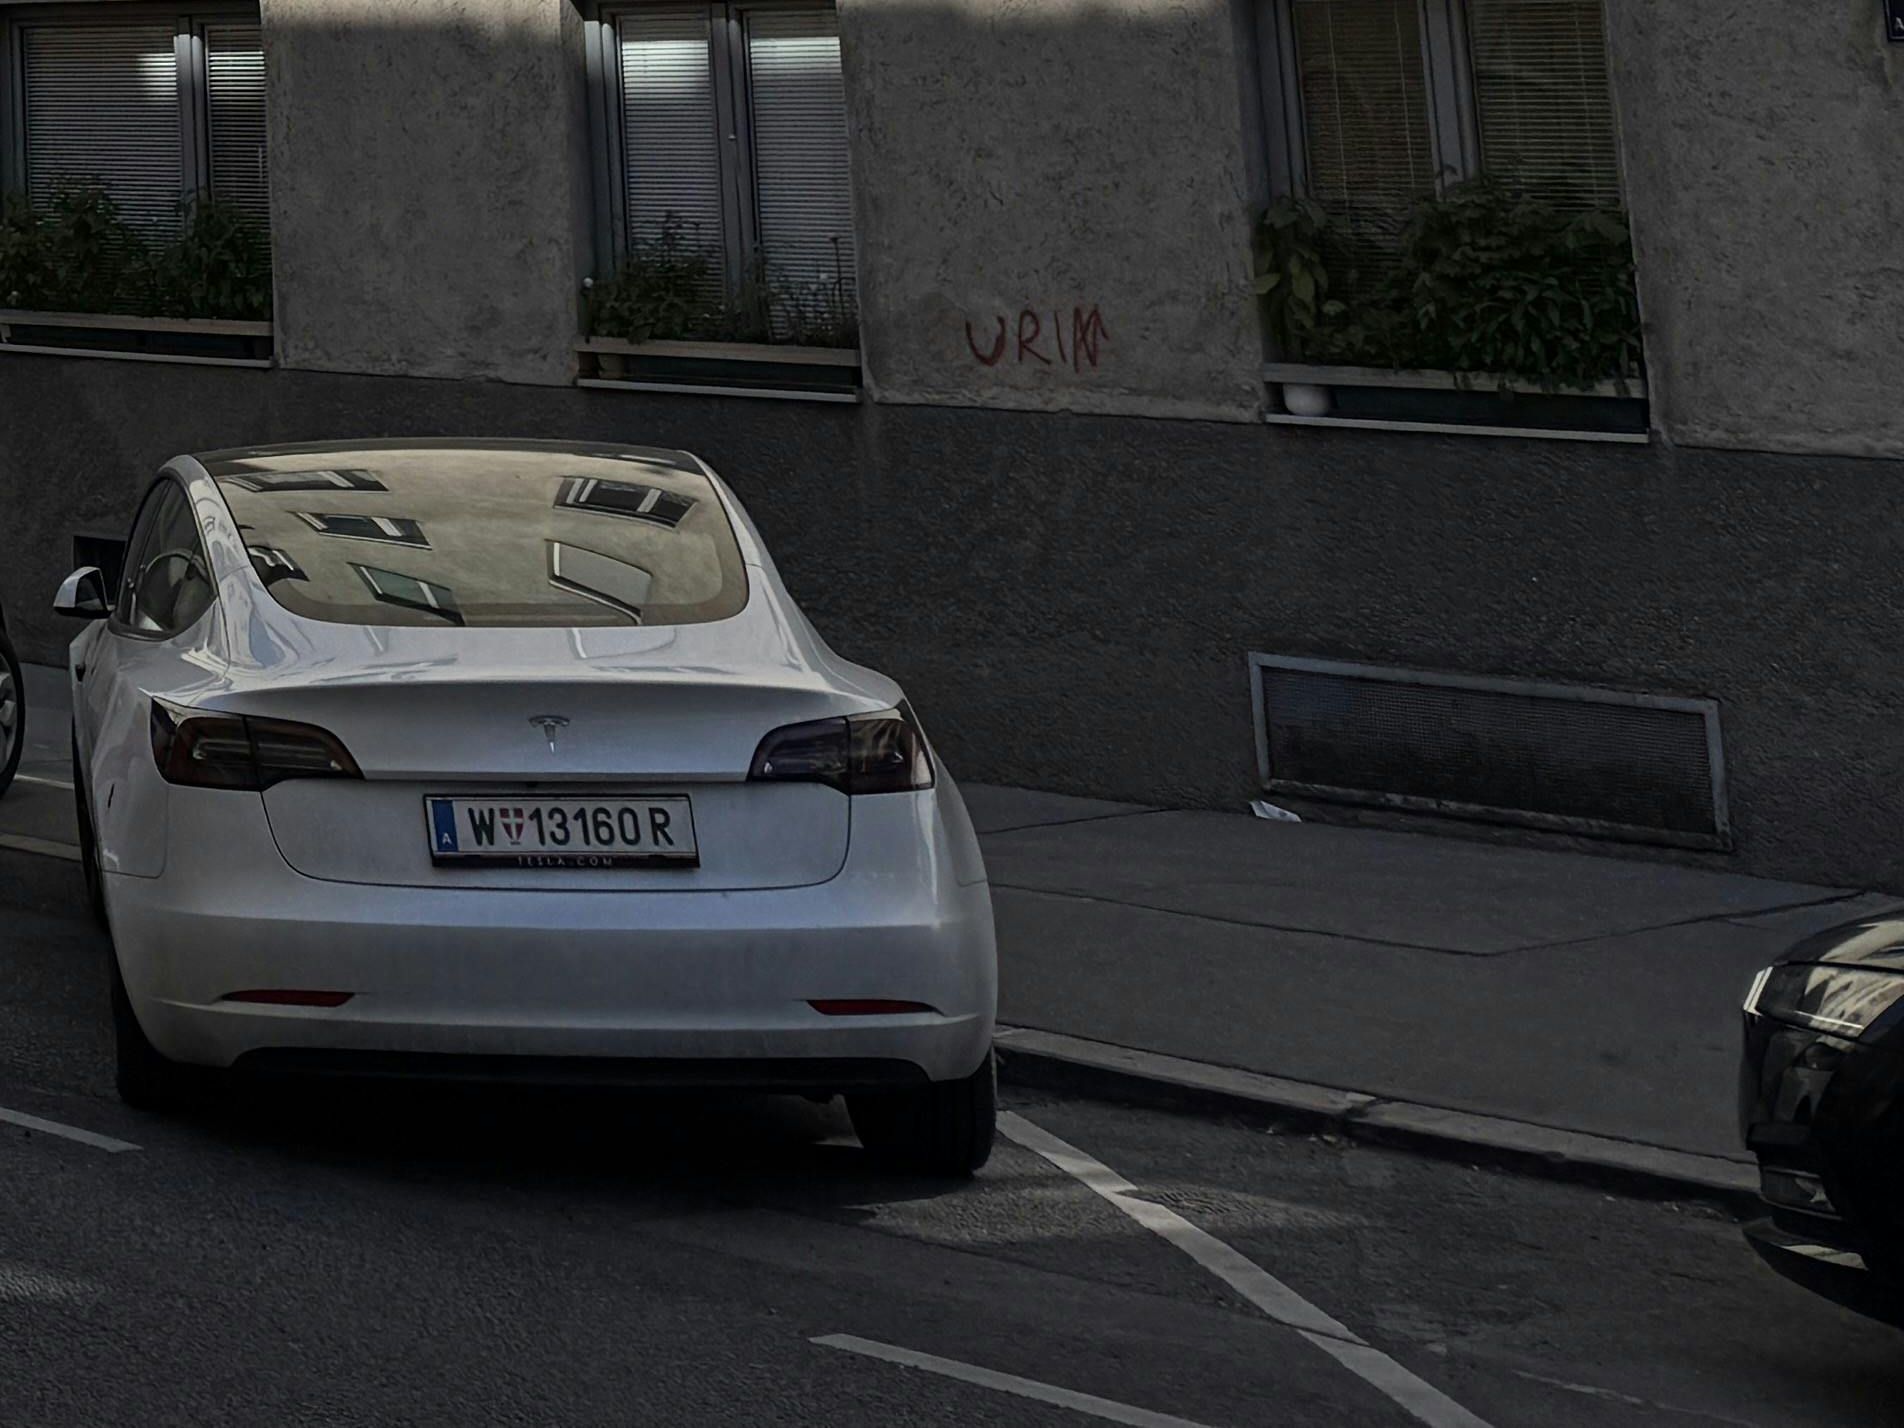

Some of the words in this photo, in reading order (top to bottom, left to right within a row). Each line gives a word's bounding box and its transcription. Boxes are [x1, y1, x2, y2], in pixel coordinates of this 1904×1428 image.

[441, 832, 453, 845] A
[468, 807, 495, 846] W
[528, 807, 641, 846] 13160
[648, 807, 674, 846] R
